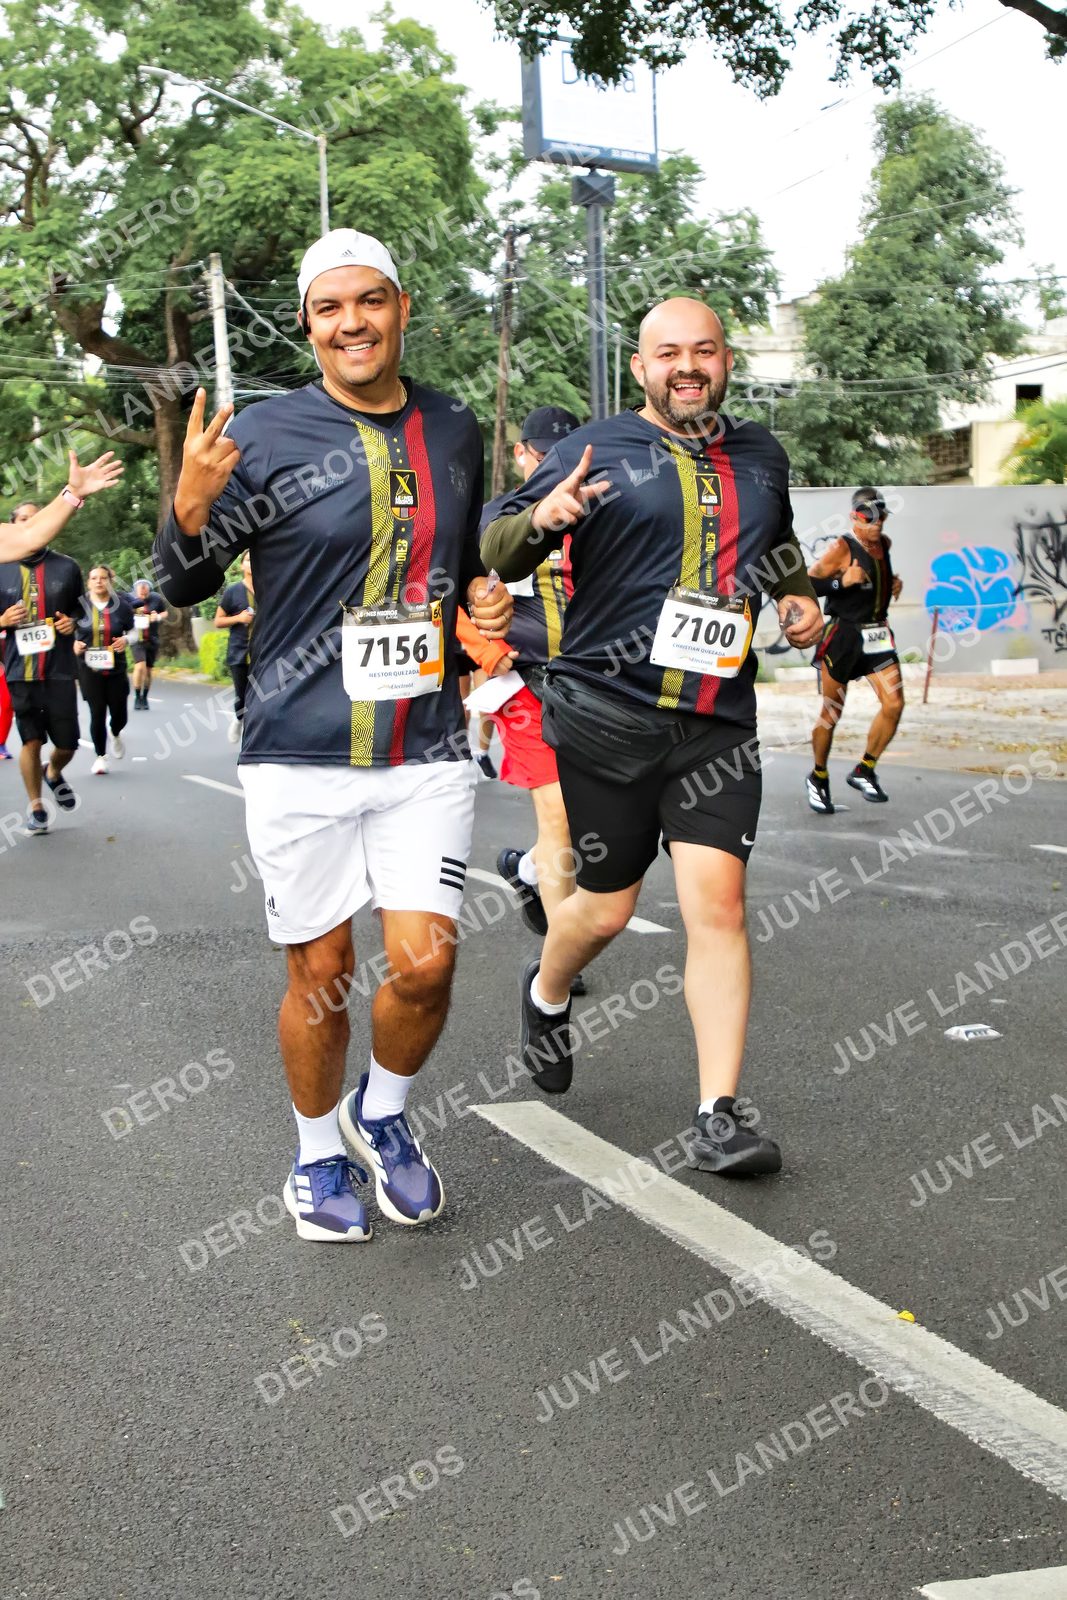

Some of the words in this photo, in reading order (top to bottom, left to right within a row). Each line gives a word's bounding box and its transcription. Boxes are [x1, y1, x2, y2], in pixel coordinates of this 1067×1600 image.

[22, 629, 48, 643] 4163
[672, 612, 736, 647] 7100
[358, 633, 428, 667] 7156
